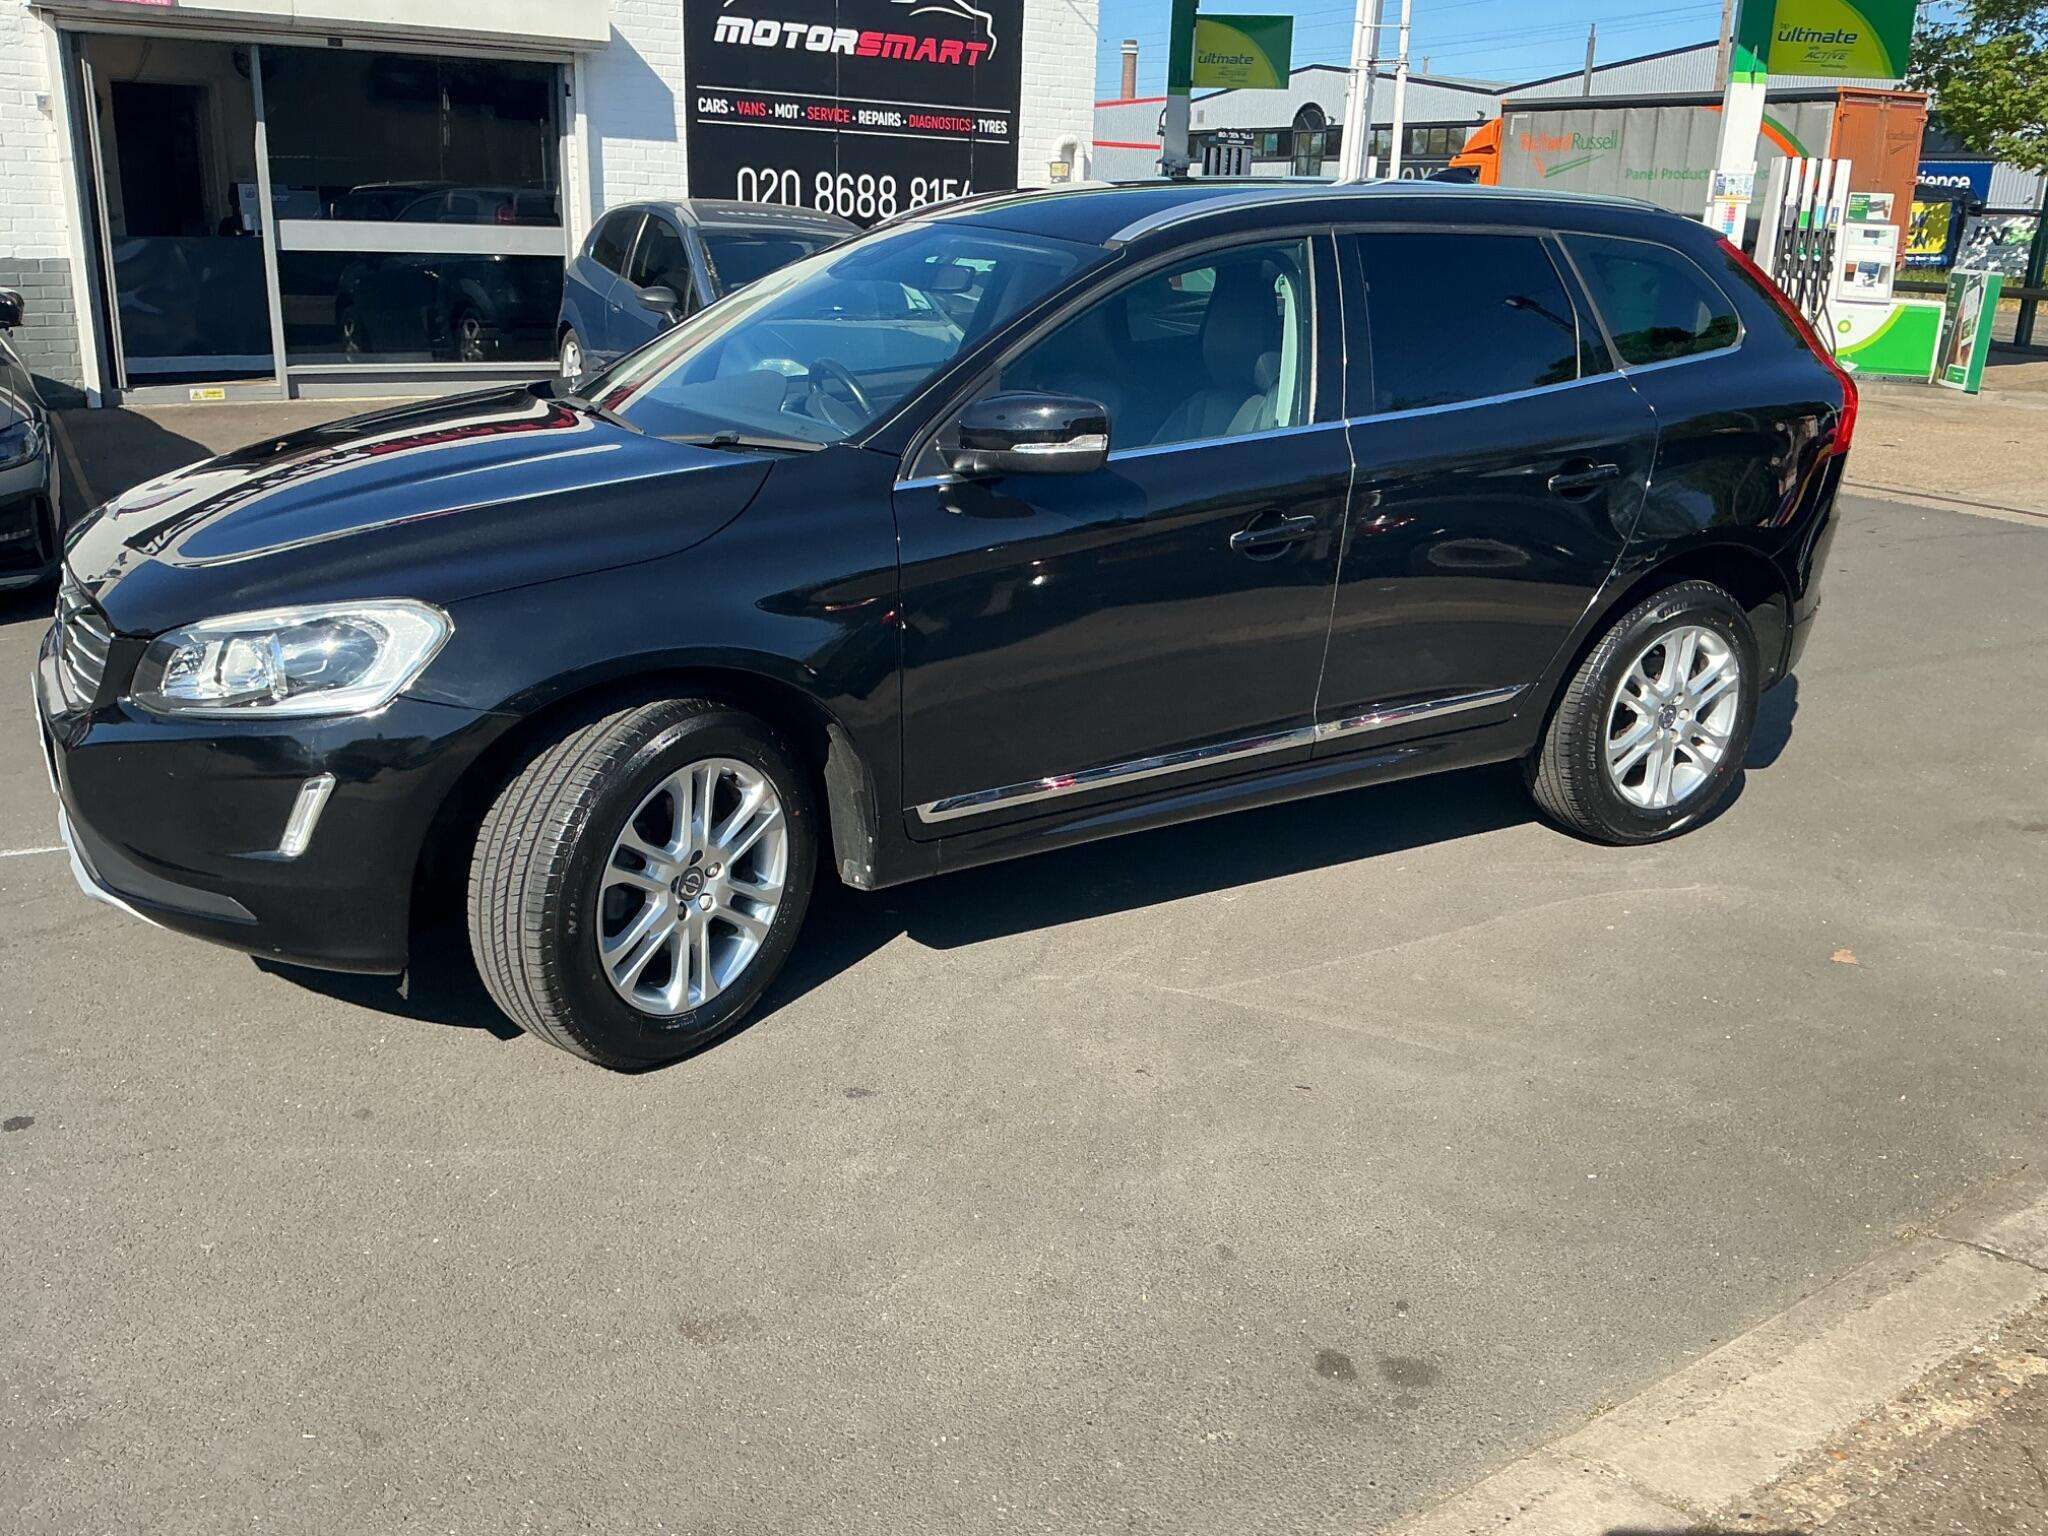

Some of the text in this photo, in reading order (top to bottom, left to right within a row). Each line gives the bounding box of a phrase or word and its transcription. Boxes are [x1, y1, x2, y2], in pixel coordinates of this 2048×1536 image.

[713, 15, 988, 66] MOTORSMART
[1778, 27, 1858, 44] ultimate
[1198, 52, 1255, 65] ultimate
[697, 97, 1008, 134] CARS VANS MOT SERVICE REPAIRS DIAGNOSTICS TYRES
[1626, 168, 1657, 180] Panel
[737, 167, 800, 207] 020
[815, 171, 897, 218] 8688
